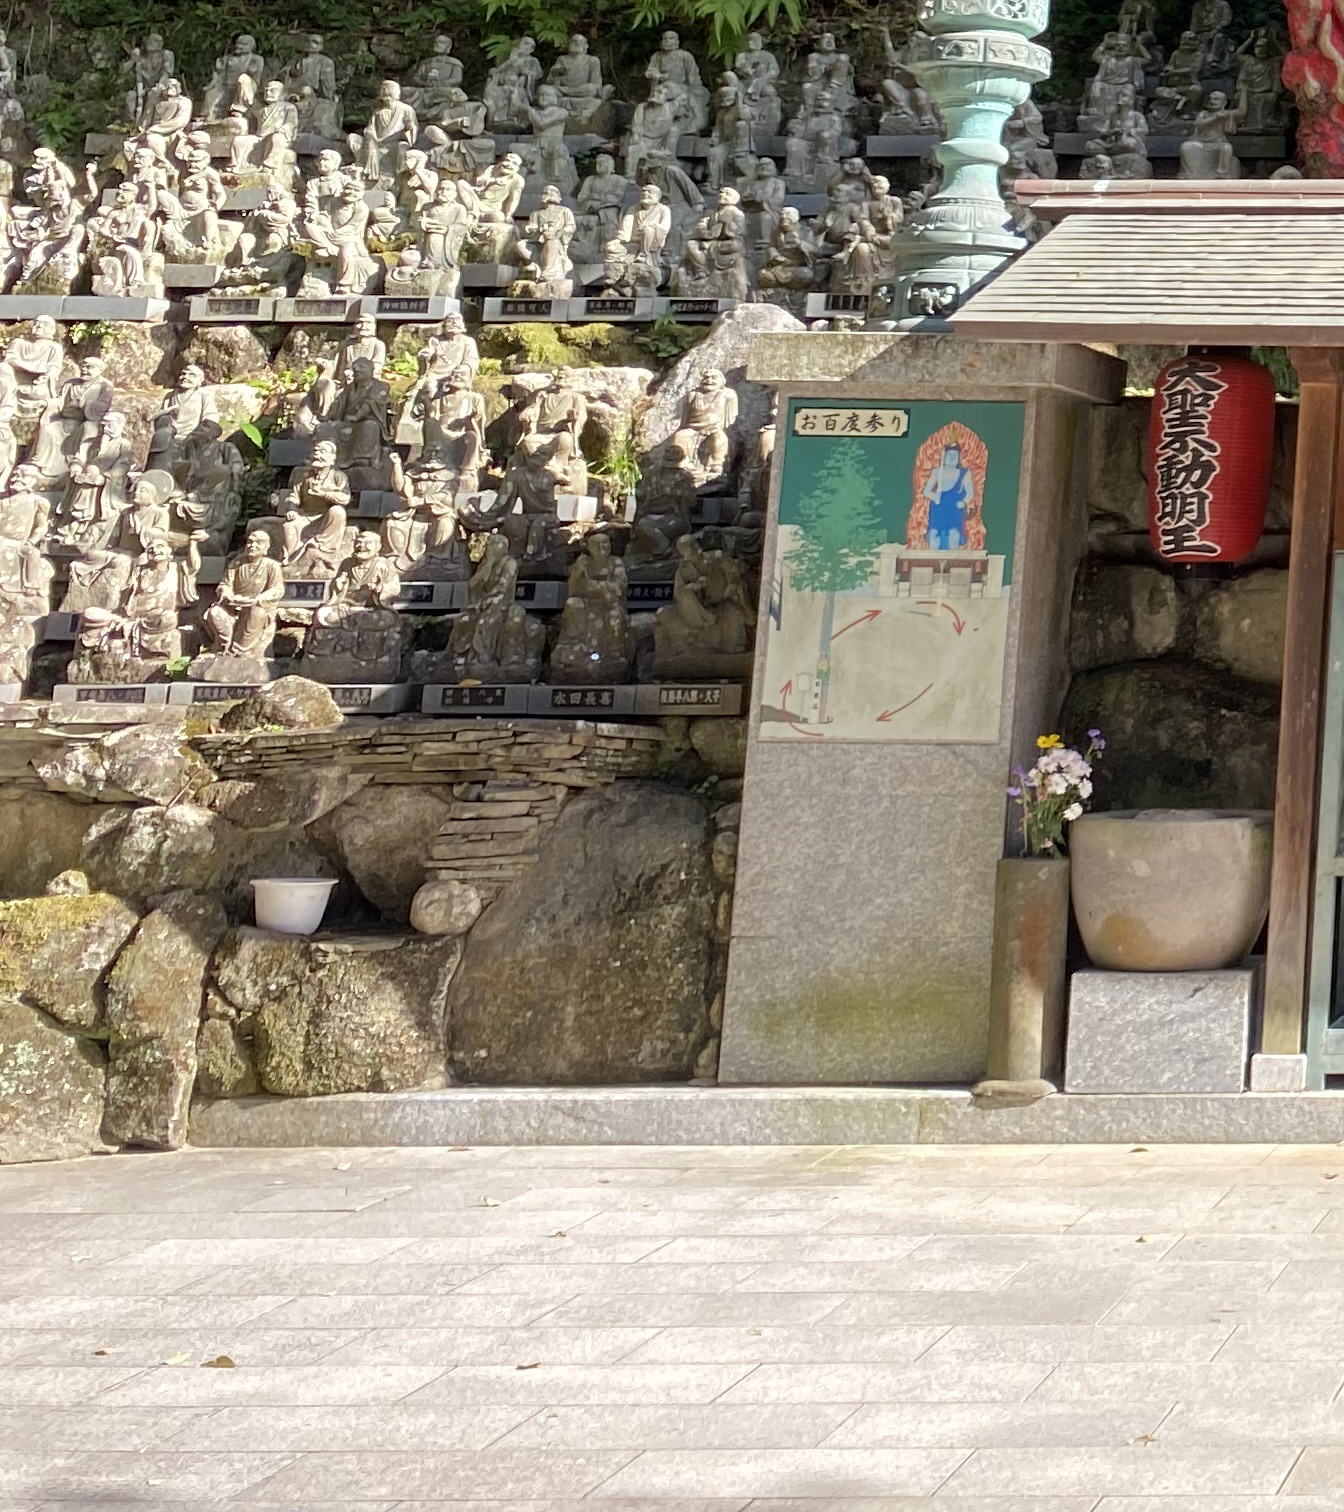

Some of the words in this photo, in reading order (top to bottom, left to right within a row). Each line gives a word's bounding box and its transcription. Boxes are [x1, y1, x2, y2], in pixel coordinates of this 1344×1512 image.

[801, 412, 901, 433] お百度参り
[1157, 361, 1226, 555] 大聖不動明王
